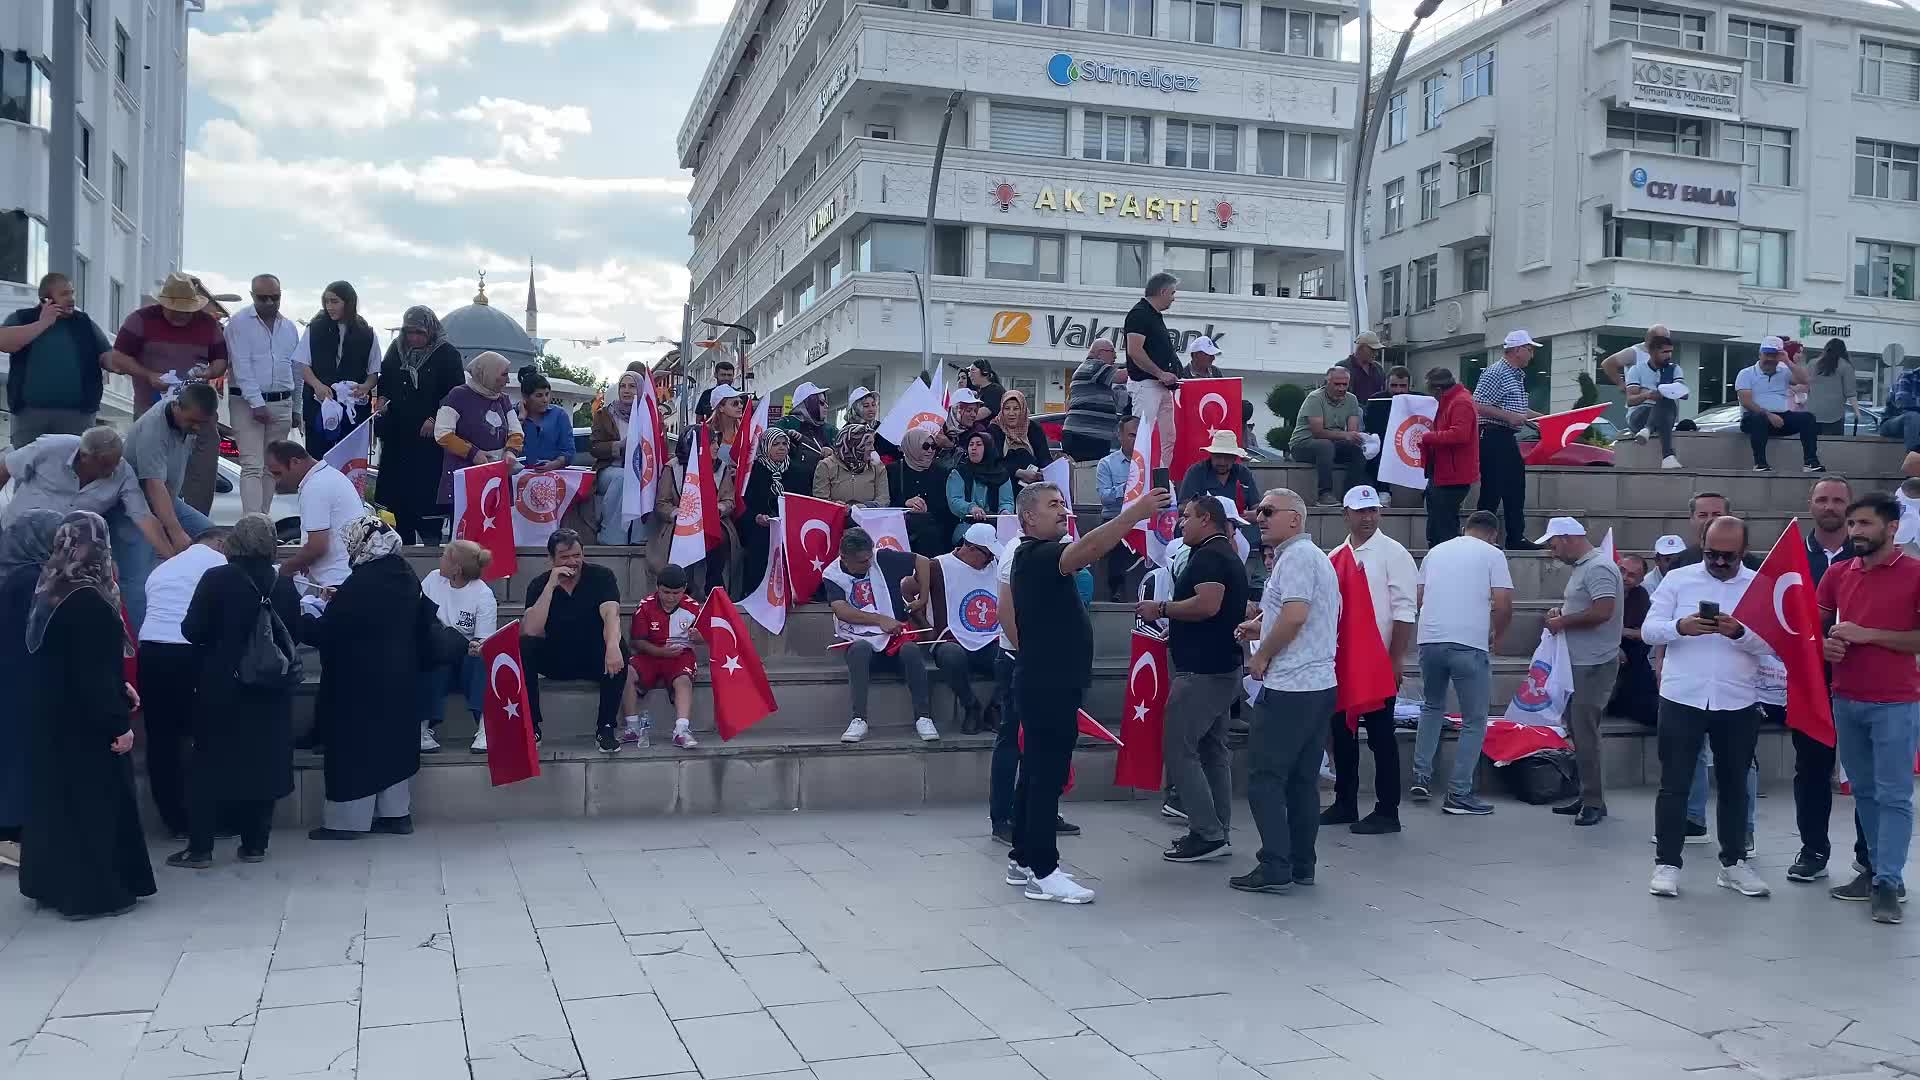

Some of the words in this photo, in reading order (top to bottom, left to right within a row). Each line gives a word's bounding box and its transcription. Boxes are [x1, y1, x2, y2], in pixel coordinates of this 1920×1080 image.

[1081, 61, 1200, 93] Sürmeligaz
[1034, 184, 1084, 213] AK
[1097, 191, 1200, 223] PARTİ
[1646, 181, 1678, 200] CEY
[1681, 185, 1737, 207] EMLAK
[1812, 321, 1851, 337] Garanti
